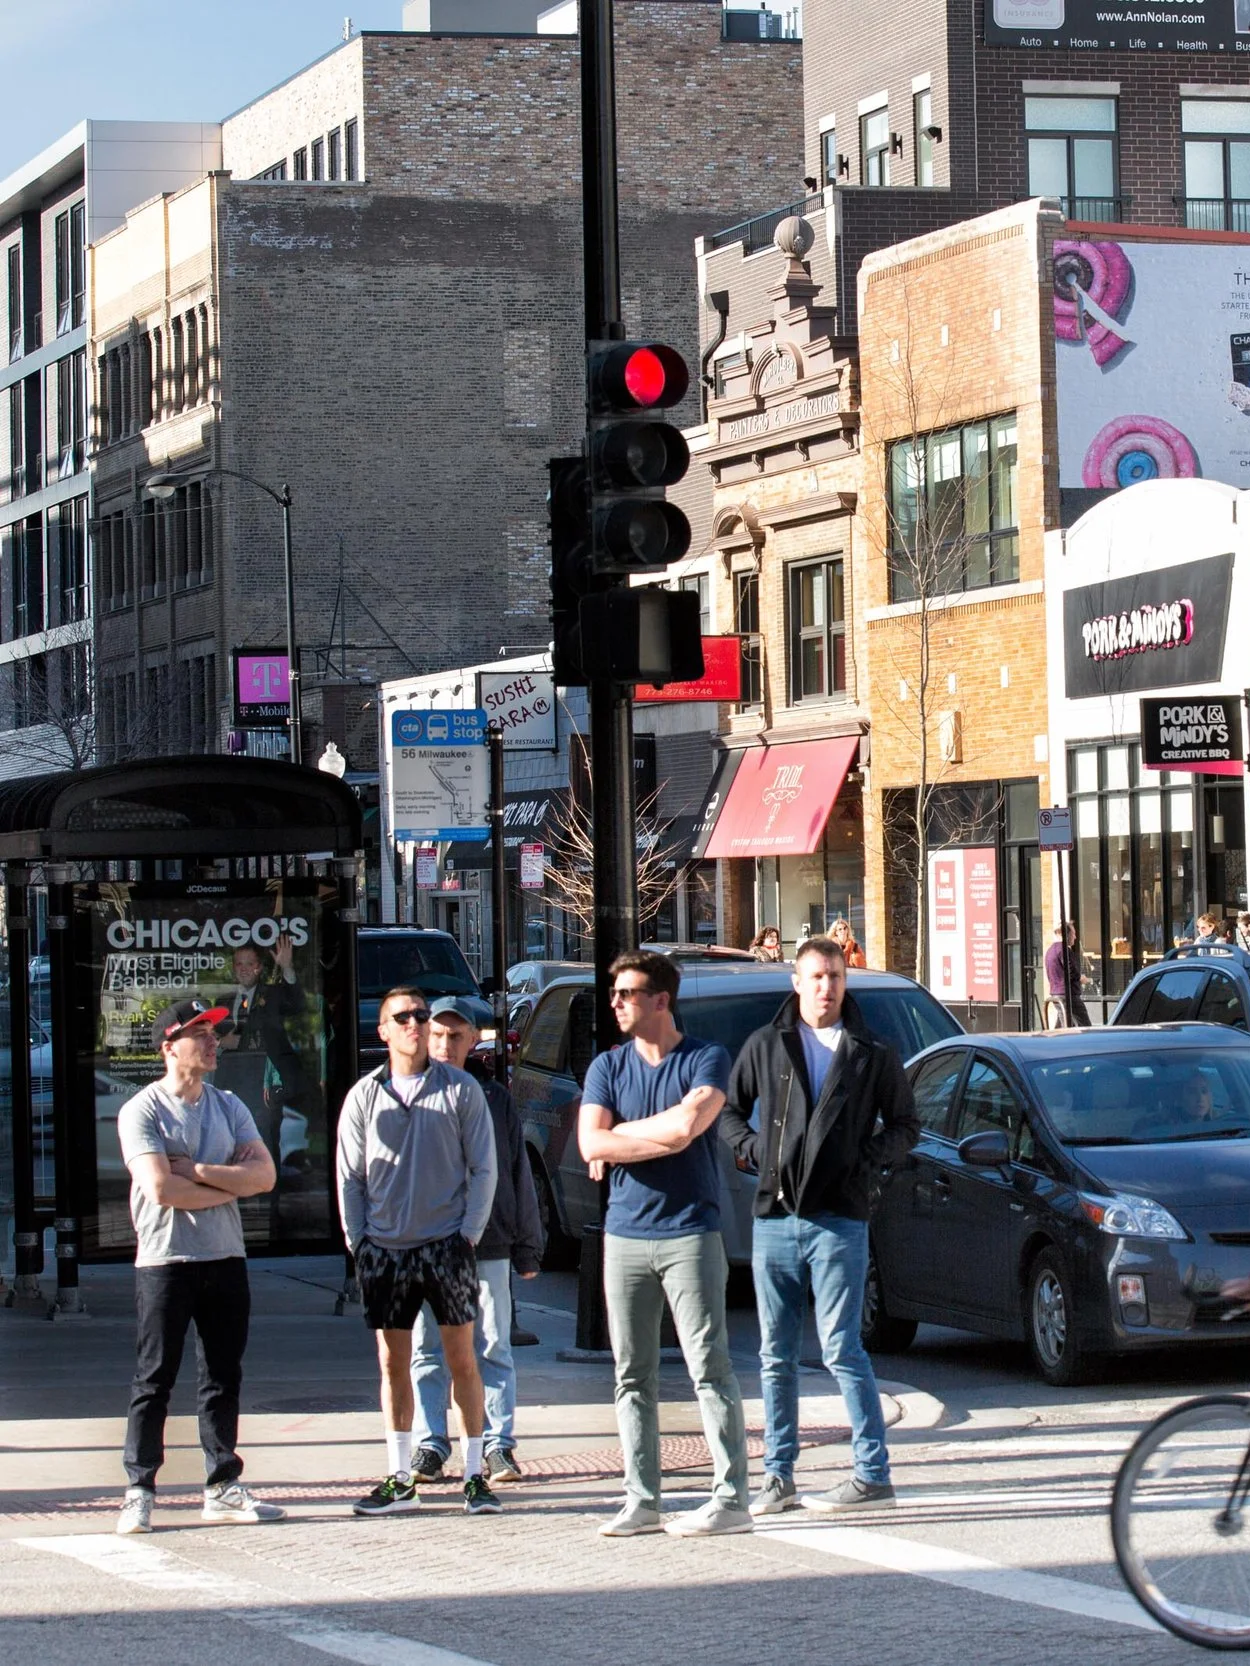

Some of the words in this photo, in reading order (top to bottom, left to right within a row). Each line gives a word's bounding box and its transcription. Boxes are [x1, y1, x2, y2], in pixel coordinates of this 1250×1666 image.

[1096, 10, 1205, 24] www.AnnNolan.com
[1020, 36, 1042, 47] Auto
[1070, 38, 1099, 48] Home
[1129, 39, 1147, 49] Life
[1176, 40, 1208, 50] Health
[1231, 292, 1245, 300] THE
[730, 413, 770, 439] PAINTERS
[773, 408, 780, 426] &
[785, 394, 839, 424] DECORATORS
[1082, 614, 1118, 657] PORK
[1118, 614, 1132, 649] &
[485, 675, 537, 711] SUSHI
[452, 713, 478, 726] bus
[1159, 705, 1206, 725] PORK
[1207, 704, 1226, 723] &
[401, 723, 419, 733] cta
[452, 728, 484, 741] stop
[514, 738, 555, 746] RESTAURANT
[401, 748, 416, 759] 56
[418, 750, 468, 759] Milwaukee
[1161, 749, 1208, 760] CREATIVE
[1208, 749, 1230, 760] BBQ
[772, 764, 806, 789] TRIM
[186, 885, 227, 893] JCDecaux
[106, 917, 309, 949] CHICAGO'S
[108, 953, 156, 971] Most
[161, 952, 225, 974] Eligible
[108, 971, 198, 990] Bachelor!
[109, 1010, 143, 1025] Ryan
